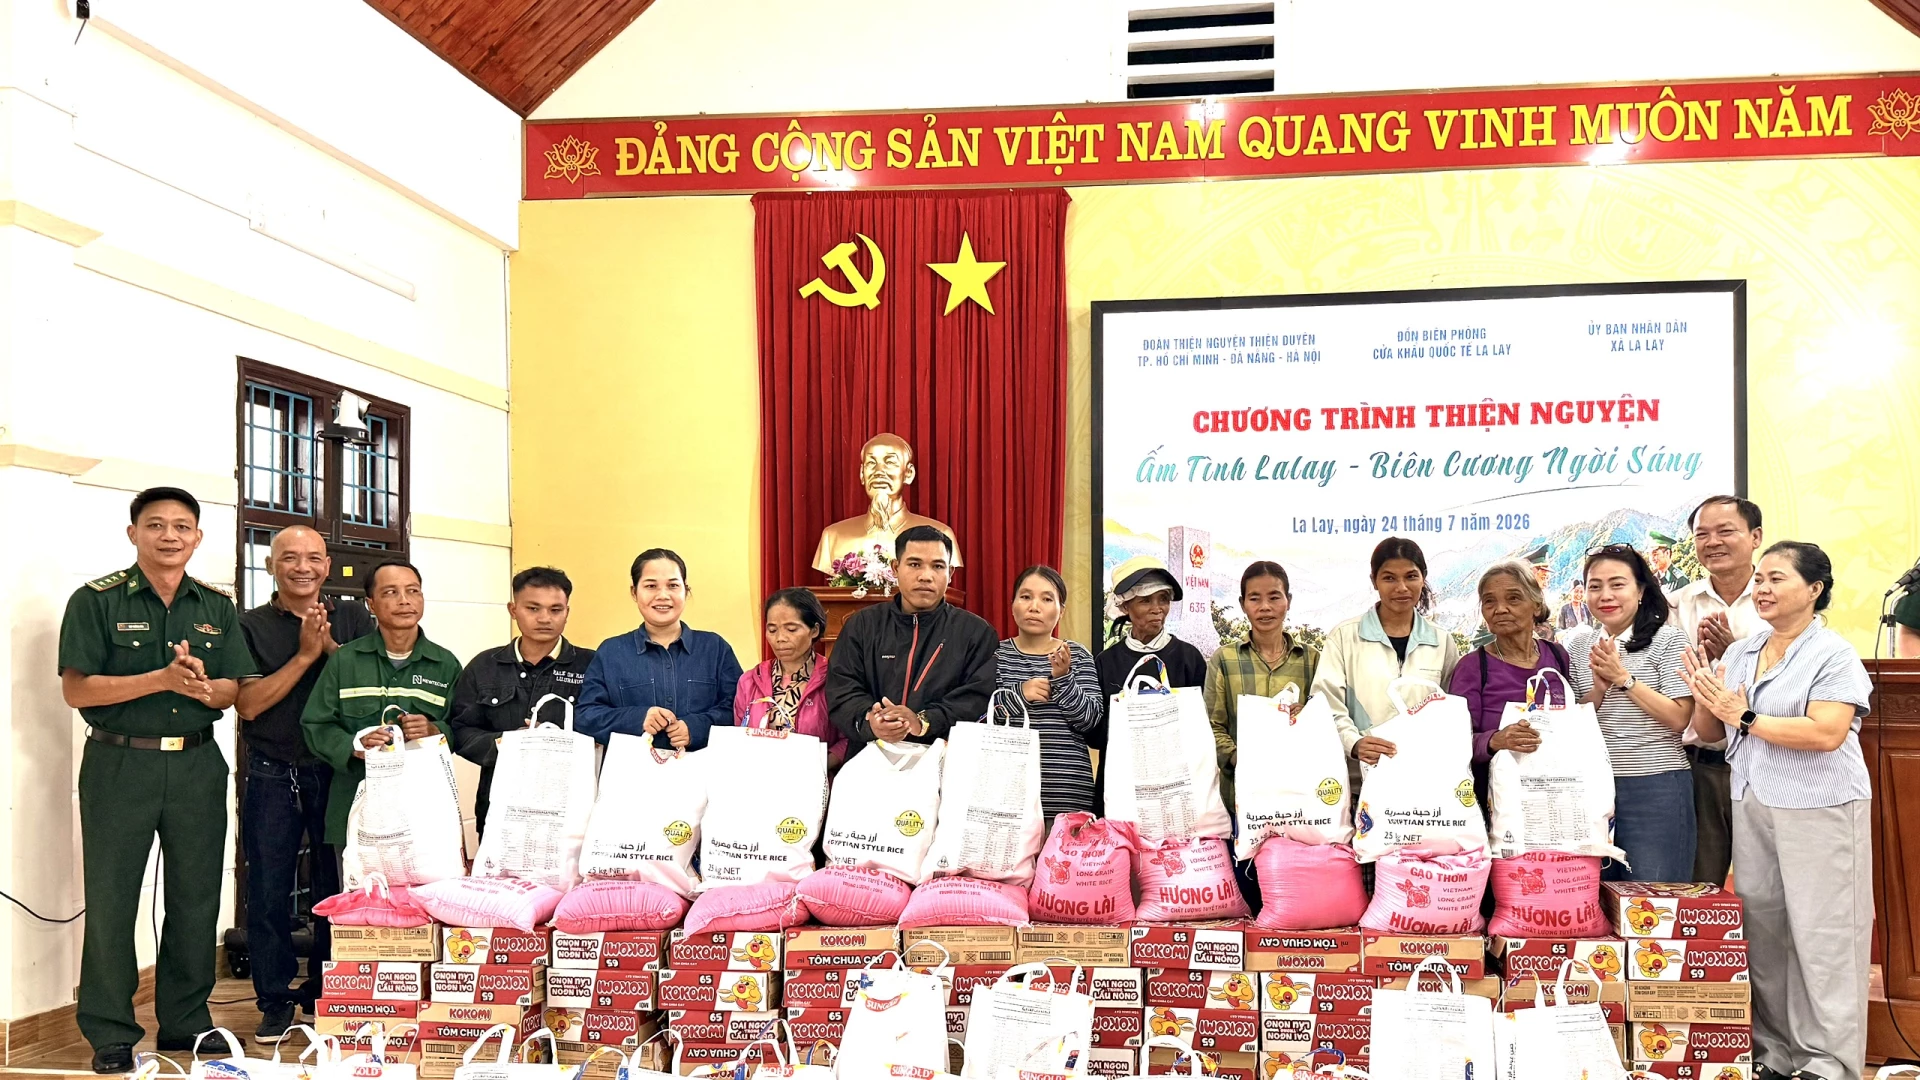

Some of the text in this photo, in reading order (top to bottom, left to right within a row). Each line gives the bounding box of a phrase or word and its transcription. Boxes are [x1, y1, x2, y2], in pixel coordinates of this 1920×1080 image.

[615, 84, 1852, 182] ĐẢNG CỘNG SẢN VIỆT NAM QUANG VINH MUÔN NĂM
[1397, 325, 1486, 342] ĐỒN BIÊN PHÒNG
[1588, 319, 1687, 335] ỦY BAN NHÂN DÂN
[1143, 332, 1315, 350] ĐOÀN THIỆN NGUYỆN THIỆN DUYÊN
[1611, 337, 1664, 352] XÃ LA LAY
[1138, 355, 1153, 367] TP.
[1156, 351, 1169, 366] HỒ
[1173, 350, 1189, 366] CHÍ
[1193, 353, 1220, 365] MINH
[1231, 351, 1244, 364] ĐÀ
[1286, 349, 1299, 362] HÀ
[1304, 348, 1321, 365] NỘI
[1373, 344, 1393, 360] CỬA
[1429, 341, 1457, 358] QUỐC
[1460, 340, 1473, 357] TẾ
[1476, 345, 1488, 356] LA
[1493, 344, 1511, 355] LAY
[1193, 393, 1660, 433] CHƯƠNG TRÌNH THIỆN NGUYỆN
[1135, 444, 1178, 483] Ấm
[1187, 455, 1247, 483] Tình
[1254, 454, 1337, 487] Lalay
[1369, 450, 1435, 479] Biên
[1443, 450, 1534, 483] Cương
[1542, 445, 1619, 483] Ngời
[1626, 444, 1703, 481] Sáng
[1292, 512, 1530, 535] La Lay, ngày 24 tháng 7 năm 2026
[1189, 602, 1205, 613] 635
[1318, 787, 1342, 796] QUALITY
[896, 819, 924, 828] QUALITY
[1426, 819, 1450, 827] STYLE
[665, 829, 692, 839] QUALITY
[777, 827, 807, 835] QUALITY
[1384, 832, 1393, 840] 25
[861, 844, 885, 852] STYLE
[887, 846, 904, 854] RICE
[723, 867, 740, 875] NET
[1410, 867, 1468, 883] GẠO THƠM
[1160, 879, 1235, 905] HƯƠNG LÀI
[1037, 889, 1115, 915] HƯƠNG LÀI
[1511, 901, 1596, 927] HƯƠNG LÀI
[1679, 909, 1740, 925] KOKOMI
[1389, 911, 1472, 934] HƯƠNG LÀI
[712, 933, 726, 943] 65
[1174, 932, 1187, 942] 65
[1681, 926, 1697, 937] 65
[493, 937, 546, 952] KOKOMI
[820, 935, 866, 947] KOKOMI
[1213, 943, 1239, 952] NGON
[1258, 938, 1337, 950] TÔM CHUA CAY
[1400, 941, 1449, 955] KOKOMI
[603, 941, 657, 958] KOKOMI
[673, 944, 728, 961] KOKOMI
[1134, 943, 1189, 959] KOKOMI
[808, 954, 861, 965] TÔM CHUA
[1278, 956, 1325, 968] KOKOMI
[1687, 951, 1747, 967] KOKOMI
[359, 964, 371, 974] 65
[324, 975, 373, 990] KOKOMI
[700, 975, 712, 984] 65
[597, 979, 649, 996] KOKOMI
[661, 985, 715, 1001] KOKOMI
[1150, 981, 1205, 998] KOKOMI
[449, 1007, 492, 1021] KOKOMI
[586, 1015, 636, 1031] KOKOMI
[1199, 1020, 1255, 1037] KOKOMI
[1692, 1032, 1749, 1049] KOKOMI
[687, 1049, 737, 1058] CHUA CAY
